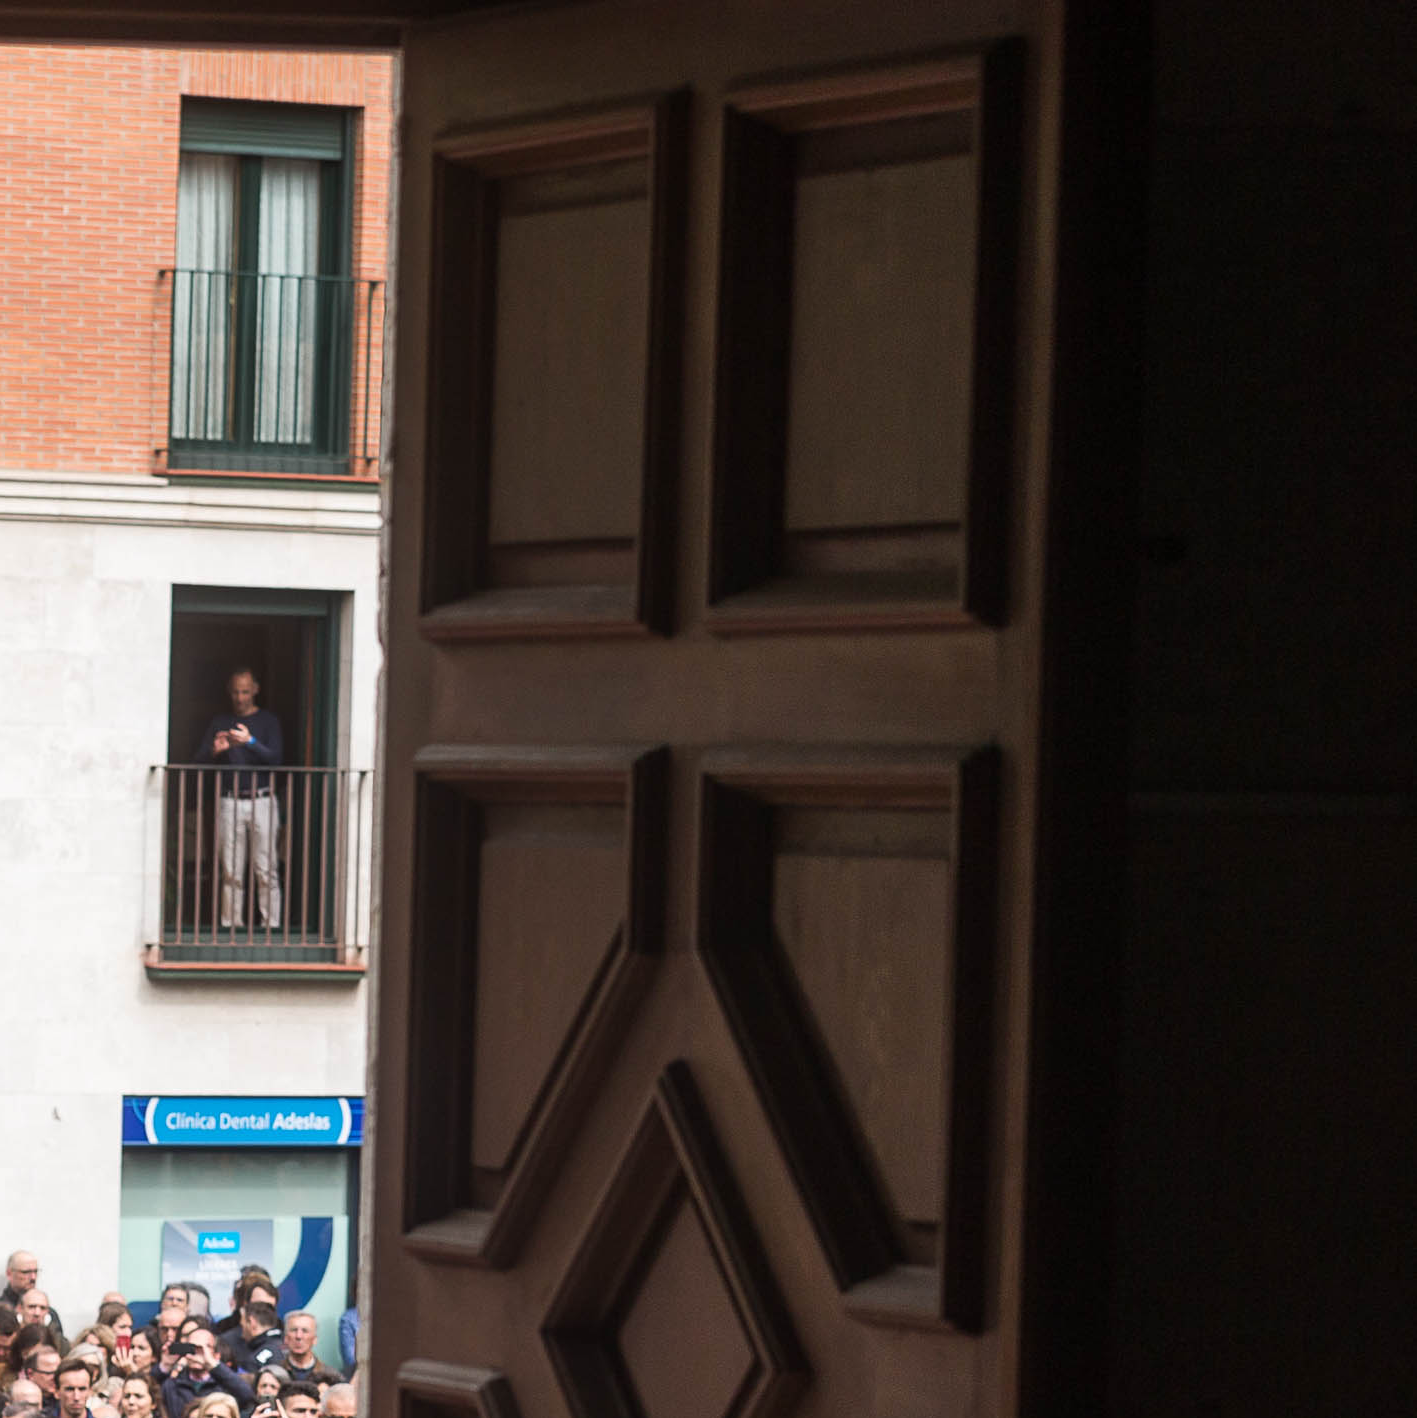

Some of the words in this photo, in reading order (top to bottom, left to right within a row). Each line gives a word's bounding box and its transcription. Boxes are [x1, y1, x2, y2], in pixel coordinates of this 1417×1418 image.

[165, 1111, 216, 1130] Clínica
[219, 1112, 270, 1130] Dental
[272, 1112, 331, 1131] Adeslas
